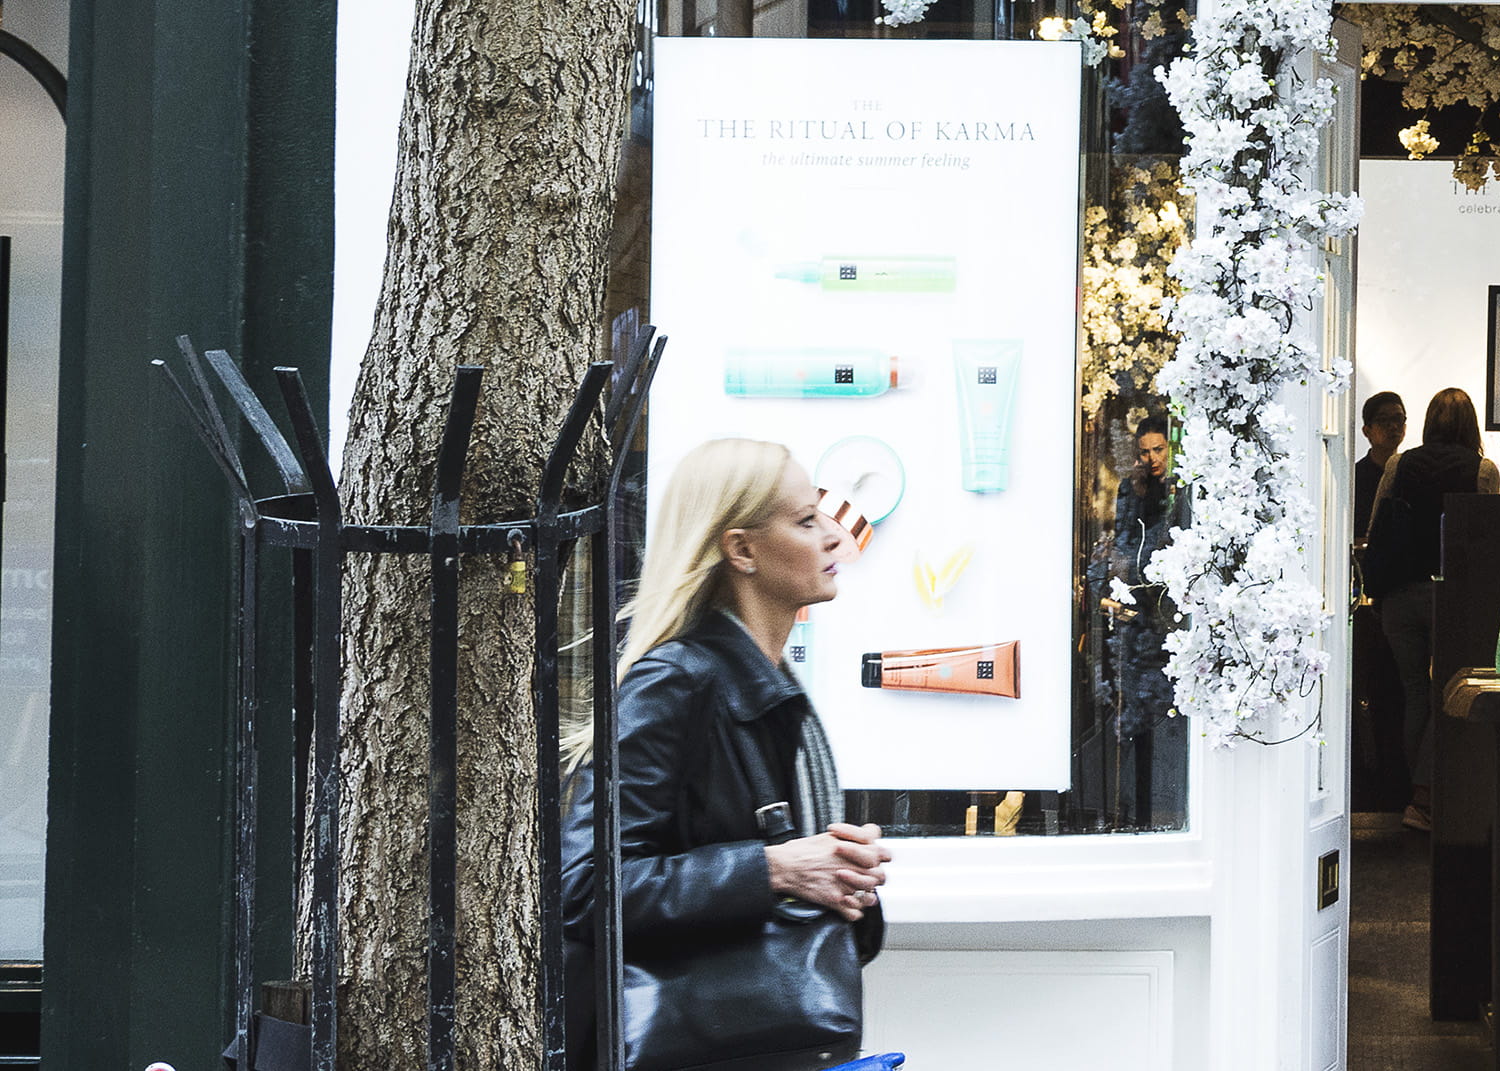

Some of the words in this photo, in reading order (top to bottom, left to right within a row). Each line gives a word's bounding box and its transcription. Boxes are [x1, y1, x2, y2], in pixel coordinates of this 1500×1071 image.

[698, 119, 756, 139] THE
[769, 119, 875, 141] RITUAL
[885, 120, 923, 141] OF
[935, 121, 1036, 142] KARMA
[762, 151, 785, 167] the
[790, 151, 854, 167] ultimate
[856, 154, 918, 168] summer
[919, 152, 972, 171] feeling
